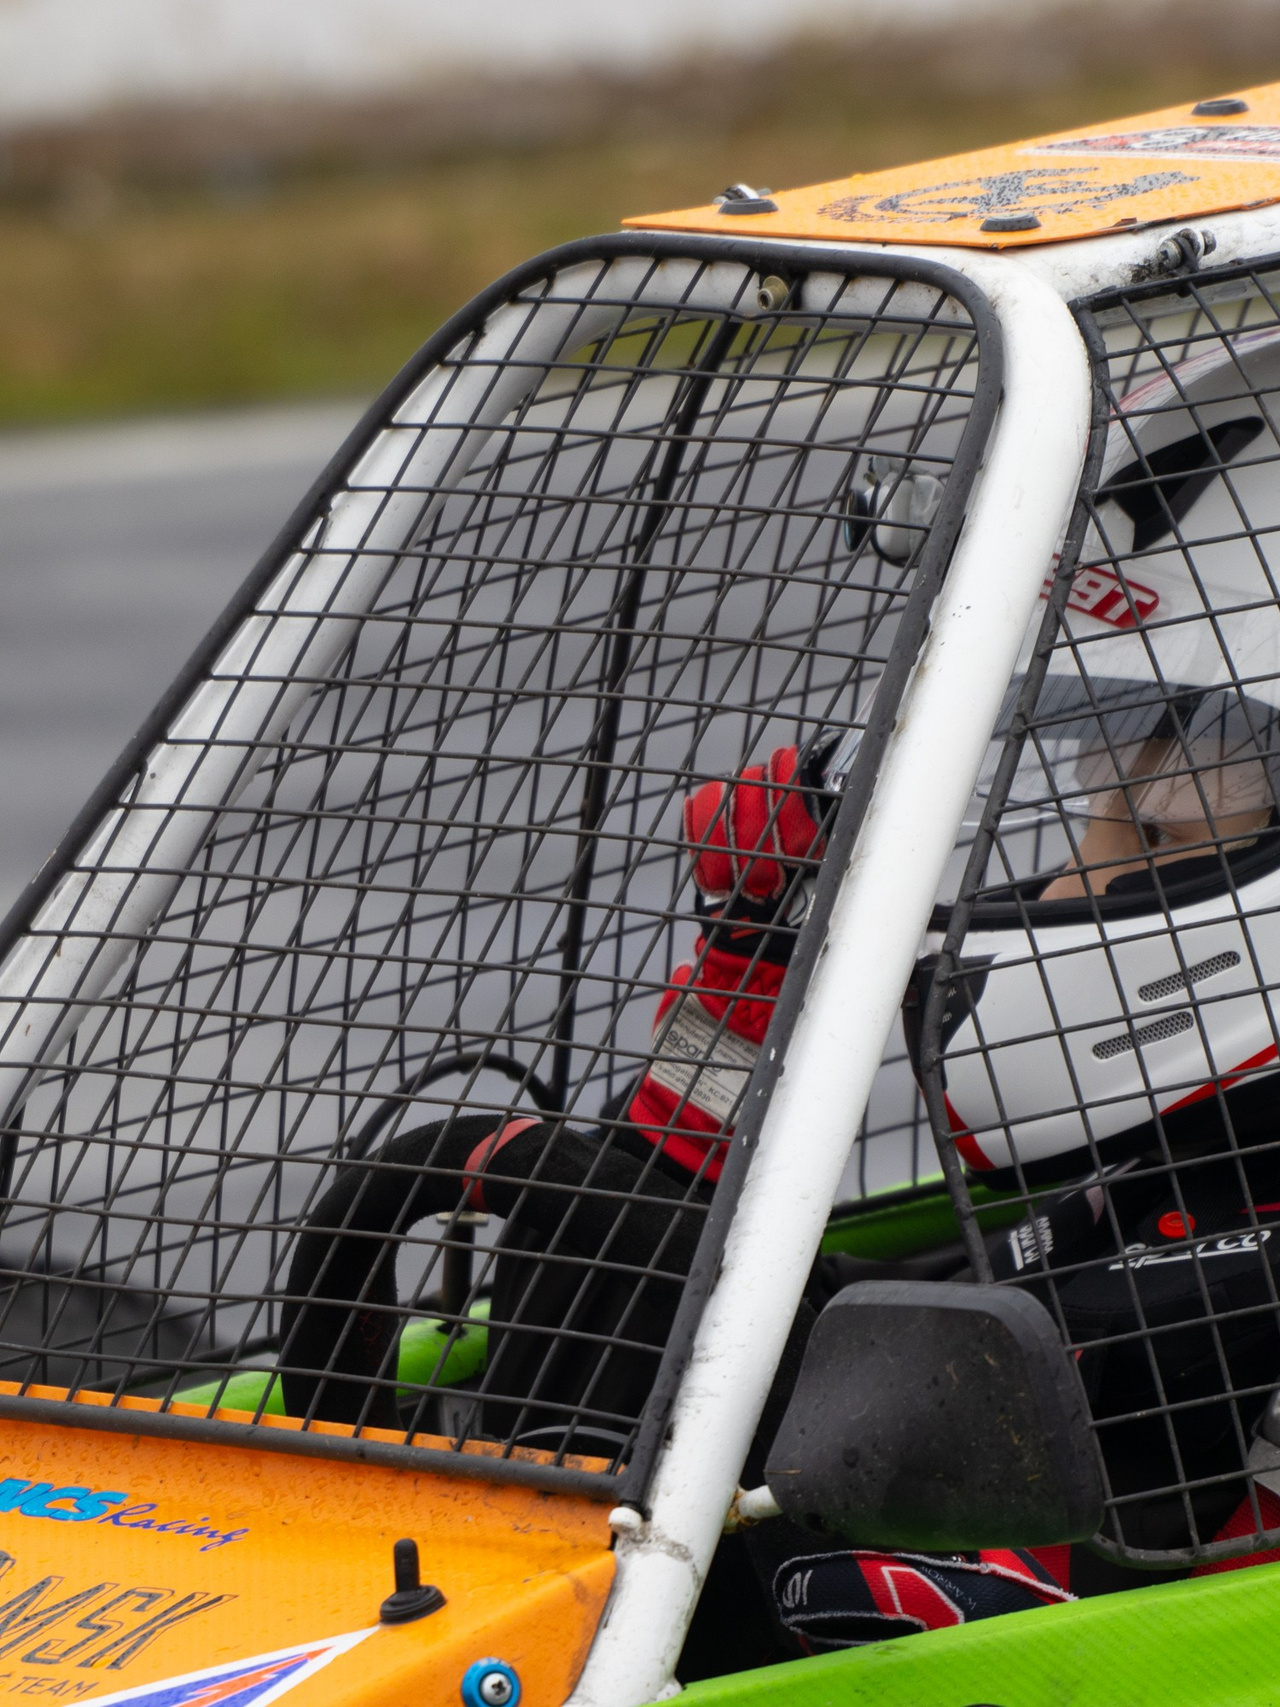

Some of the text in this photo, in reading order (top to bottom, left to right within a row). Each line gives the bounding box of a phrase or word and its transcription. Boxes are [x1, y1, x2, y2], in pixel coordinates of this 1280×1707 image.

[98, 1503, 250, 1552] Racing
[0, 1551, 238, 1670] MSK
[8, 1676, 99, 1698] TEAM
